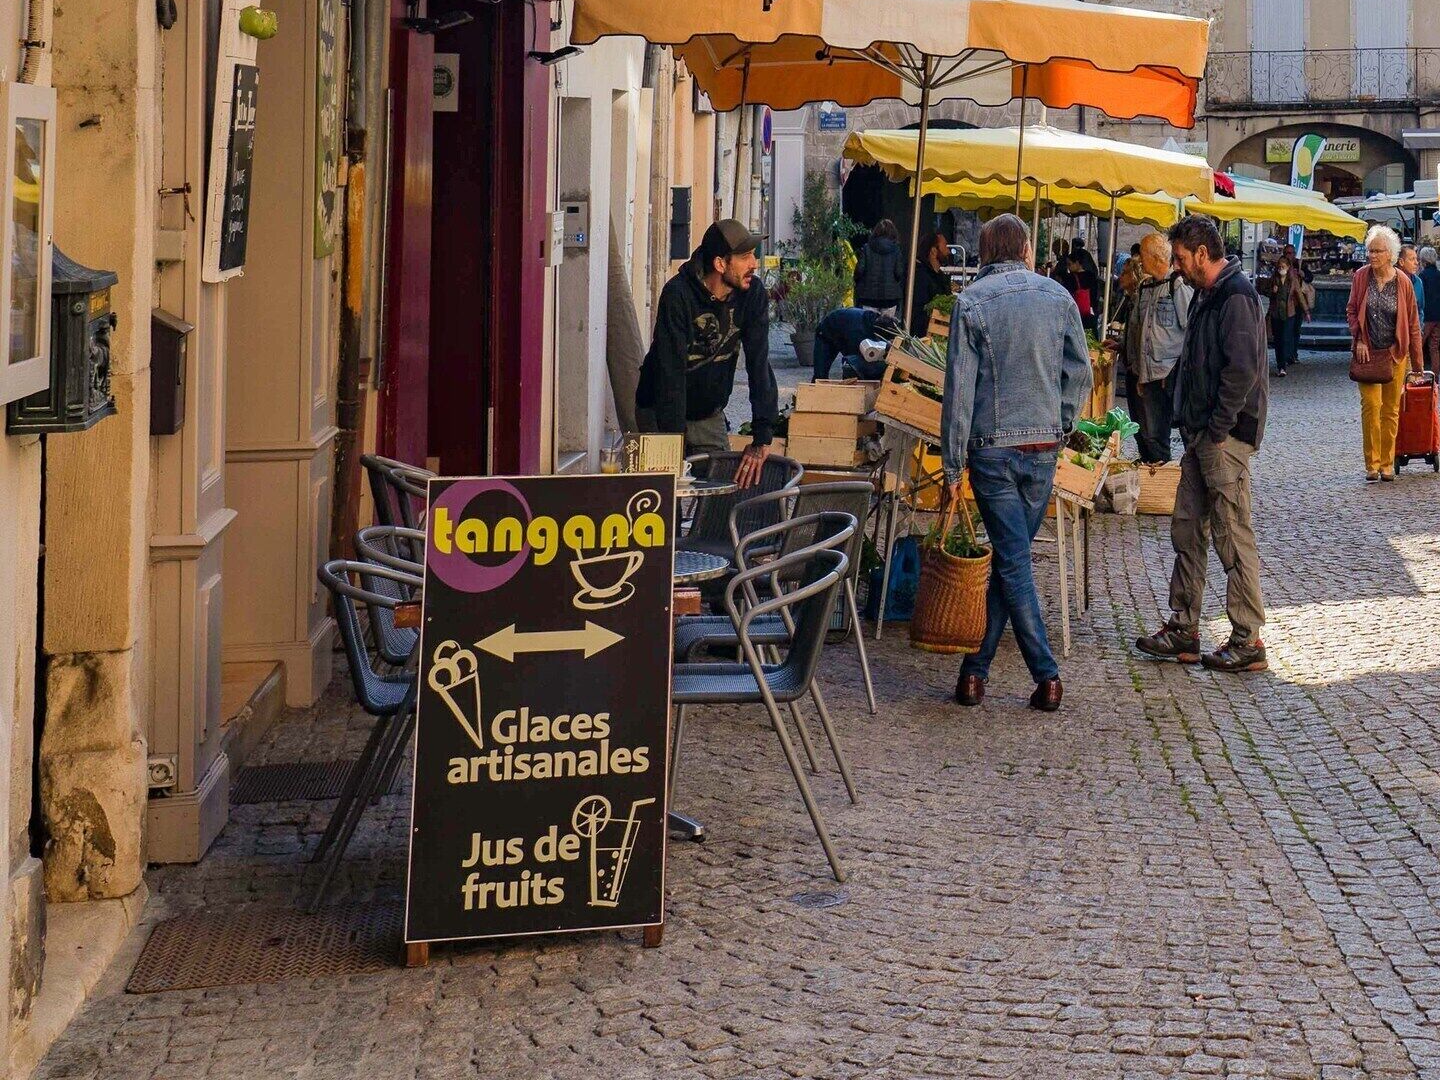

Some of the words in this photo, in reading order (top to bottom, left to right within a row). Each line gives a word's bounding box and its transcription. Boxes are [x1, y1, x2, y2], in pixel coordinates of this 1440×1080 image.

[434, 507, 666, 566] tangana
[491, 706, 611, 745] Glaces
[447, 739, 650, 784] artisanales
[462, 832, 524, 869] Jus
[534, 825, 580, 862] de
[462, 870, 565, 910] fruits
